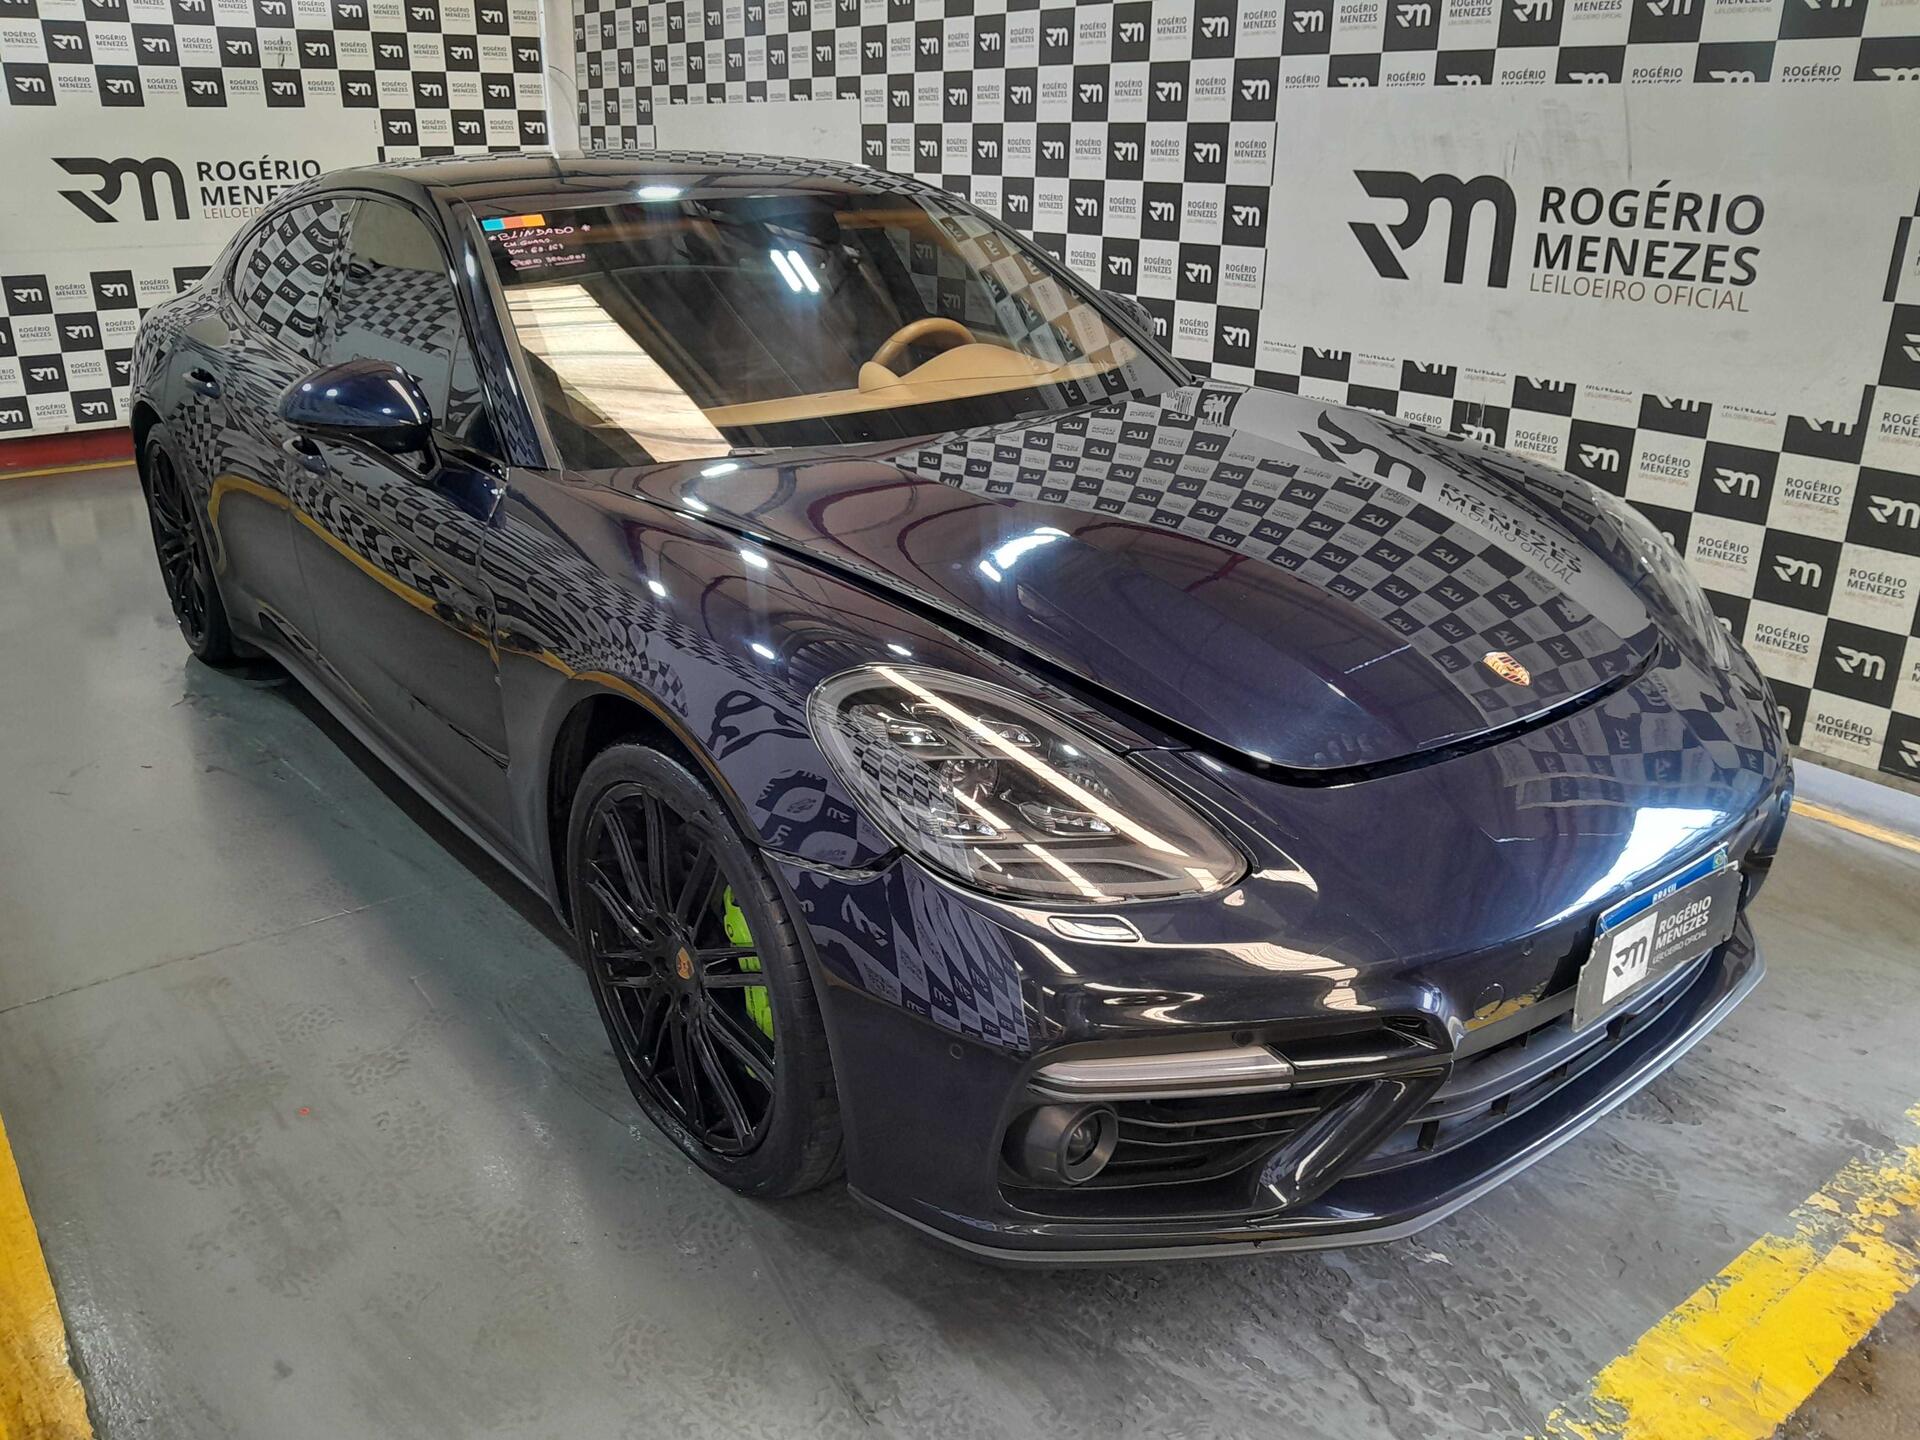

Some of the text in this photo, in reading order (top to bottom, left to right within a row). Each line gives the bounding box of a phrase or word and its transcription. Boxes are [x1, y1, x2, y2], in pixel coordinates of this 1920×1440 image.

[1340, 4, 1378, 14] ROGÉRIO
[1450, 7, 1492, 17] MENEZES
[1574, 0, 1622, 12] MENEZES
[1244, 10, 1277, 20] ROGÉRIO
[1340, 14, 1378, 23] MENEZES
[1157, 25, 1186, 34] MENEZES
[1243, 20, 1276, 28] MENEZES
[1387, 72, 1426, 82] ROGÉRIO
[1502, 67, 1546, 80] ROGÉRIO
[1632, 65, 1683, 78] ROGÉRIO
[1783, 63, 1841, 78] ROGÉRIO
[1196, 78, 1226, 86] ROGÉRIO
[1285, 74, 1320, 84] ROGÉRIO
[1234, 140, 1267, 148] ROGÉRIO
[1234, 150, 1266, 158] MENEZES
[196, 155, 320, 182] ROGÉRIO
[200, 184, 292, 206] MENE
[1187, 209, 1218, 218] MENEZES
[1539, 179, 1765, 235] ROGÉRIO
[1070, 258, 1096, 267] MENEZES
[1533, 232, 1760, 286] MENEZES
[1144, 265, 1172, 274] MENEZES
[1226, 264, 1257, 273] ROGÉRIO
[1224, 272, 1256, 282] MENEZES
[1530, 272, 1749, 312] LEILOEIRO OFICIAL
[1179, 326, 1208, 336] MENEZES
[1404, 411, 1442, 424] ROGÉRIO
[1515, 430, 1558, 444] ROGÉRIO
[1514, 440, 1558, 454] MENEZES
[1642, 452, 1691, 468] ROGÉRIO
[1640, 462, 1689, 478] MENEZES
[1786, 478, 1842, 495] ROGÉRIO
[1784, 488, 1840, 506] MENEZES
[1698, 536, 1750, 554] ROGÉRIO
[1696, 546, 1748, 564] MENEZES
[1520, 541, 1574, 585] OFICIAL
[1849, 568, 1908, 588] ROGÉRIO
[1847, 578, 1905, 598] MENEZES
[1756, 624, 1810, 643] ROGÉRIO
[1754, 634, 1808, 654] MENEZES
[1817, 714, 1872, 736] ROGÉRIO
[1815, 724, 1872, 746] MENEZES
[1652, 883, 1677, 904] BRASIL
[1658, 896, 1712, 934] ROGÉRIO
[1655, 910, 1710, 950] MENEZES
